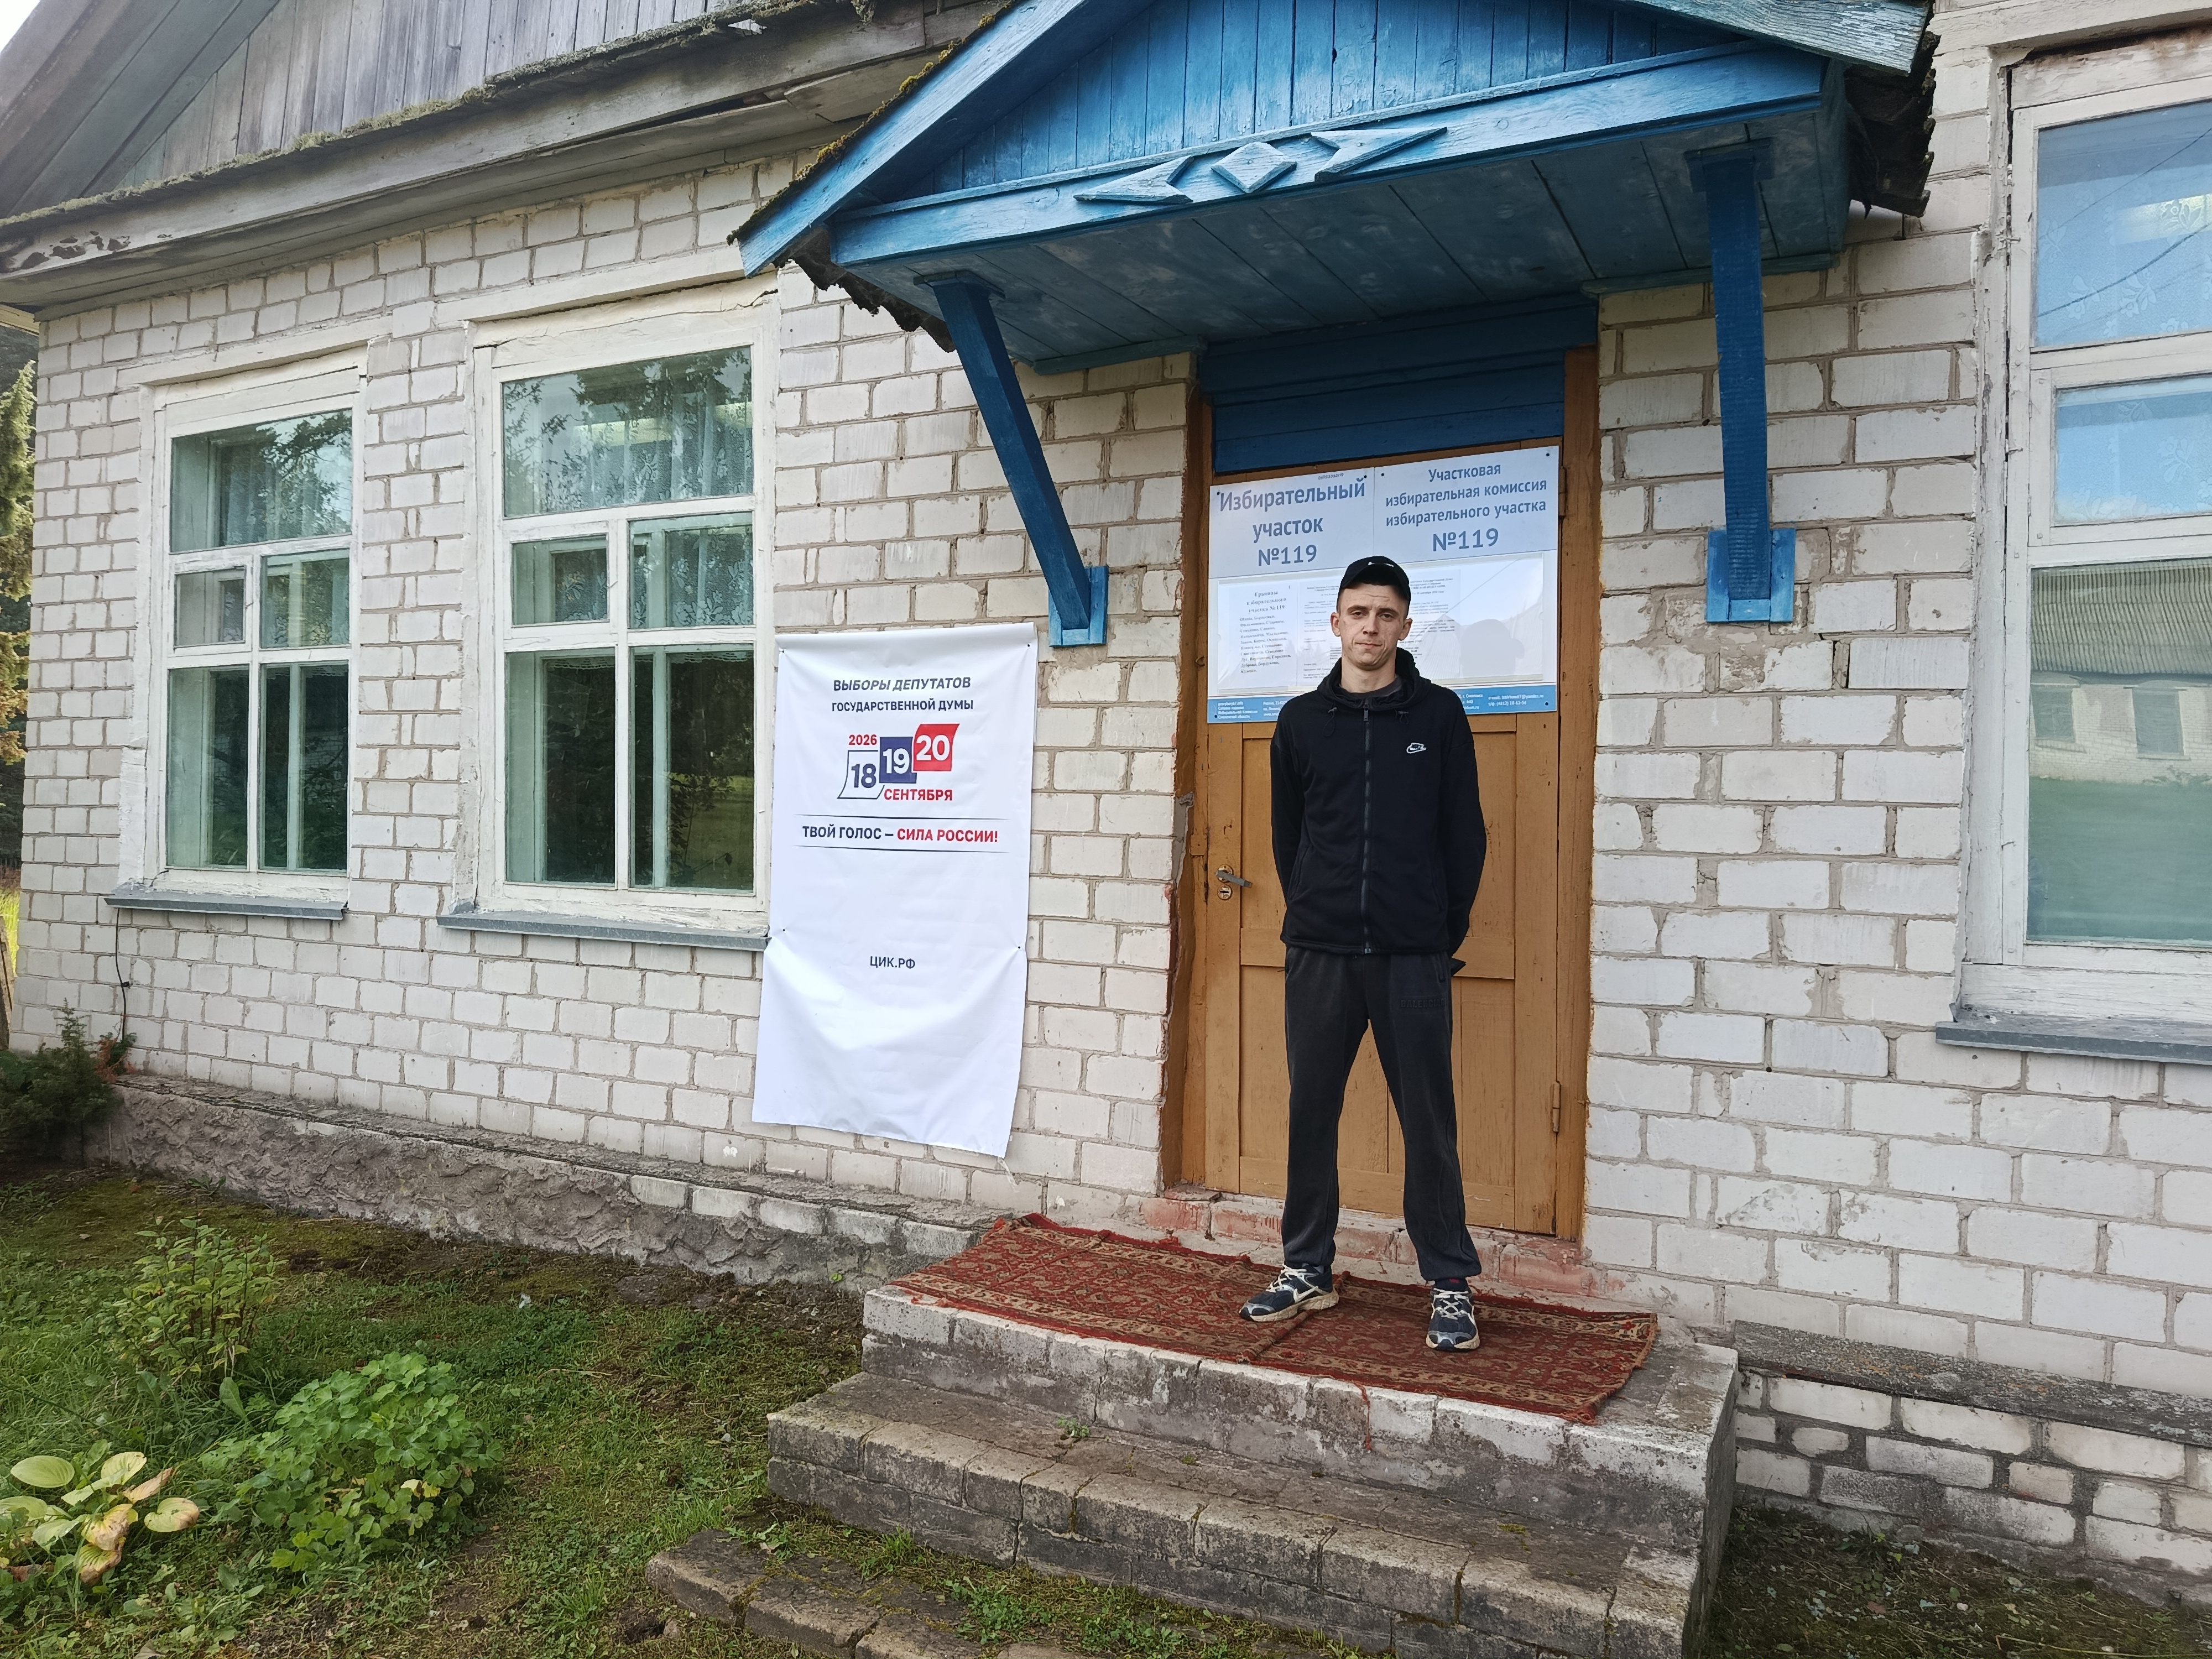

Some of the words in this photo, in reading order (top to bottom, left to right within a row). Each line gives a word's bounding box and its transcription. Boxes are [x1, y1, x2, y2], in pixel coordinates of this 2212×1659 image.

[1428, 465, 1501, 482] Участковая
[1220, 477, 1365, 512] Избирательный
[1386, 487, 1480, 507] избирательная
[1484, 480, 1547, 497] комиссия
[1386, 506, 1490, 527] избирательного
[1494, 500, 1546, 519] участка
[1253, 518, 1323, 543] участок
[1433, 528, 1499, 552] №119
[1258, 544, 1317, 566] №119
[833, 680, 891, 691] ВЫБОРЫ
[892, 677, 971, 691] ДЕПУТАТОВ
[832, 697, 936, 713] ГОСУДАРСТВЕННОЙ
[938, 700, 973, 712] ДУМЫ
[848, 734, 878, 746] 2026
[851, 763, 877, 789] 18
[882, 747, 910, 774] 19
[916, 734, 951, 761] 20
[884, 789, 953, 801] СЕНТЯБРЯ
[802, 824, 836, 838] ТВОЙ
[839, 827, 881, 839] ГОЛОС
[897, 828, 933, 841] СИЛА
[937, 830, 998, 843] РОССИИ!
[869, 956, 916, 969] ЦИК.РФ
